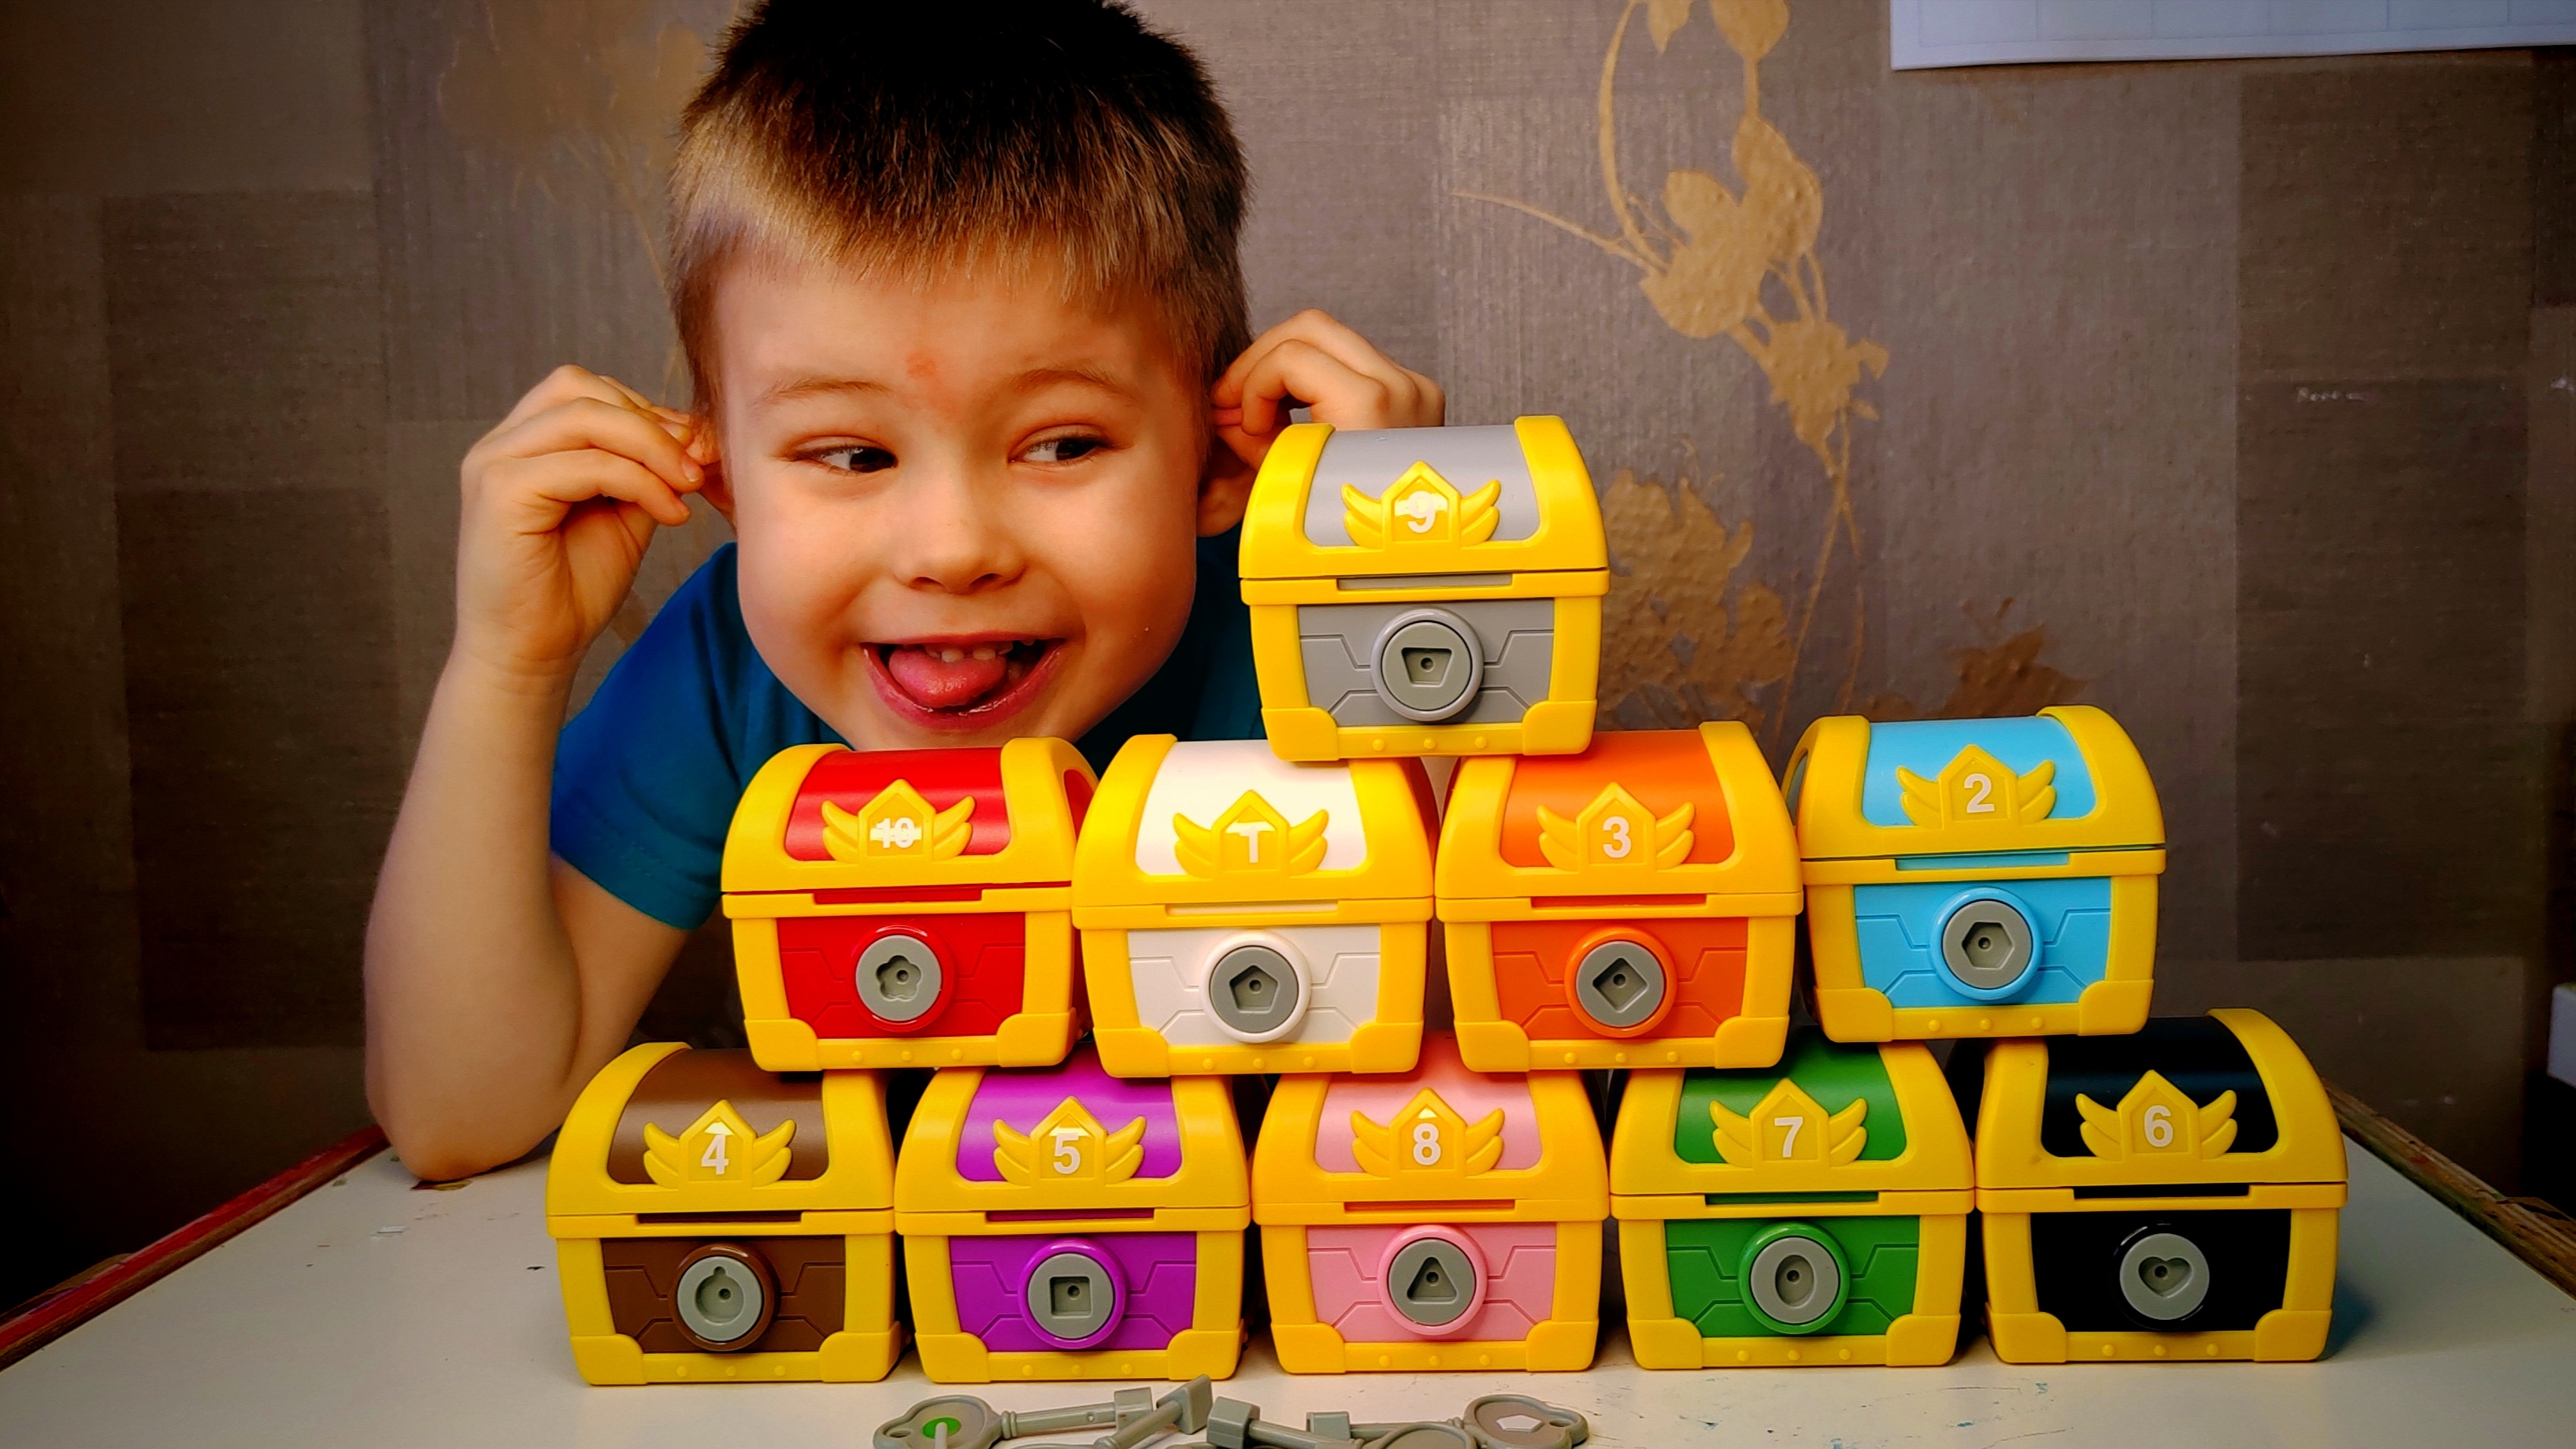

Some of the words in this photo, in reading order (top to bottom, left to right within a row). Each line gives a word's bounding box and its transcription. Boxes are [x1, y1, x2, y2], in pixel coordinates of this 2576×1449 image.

[1407, 491, 1436, 533] 9
[1964, 773, 1995, 813] 2
[876, 817, 914, 849] 10
[1602, 816, 1632, 858] 3
[1413, 1122, 1442, 1166] 8
[1774, 1116, 1803, 1158] 7
[2144, 1105, 2174, 1147] 6
[701, 1132, 730, 1175] 4
[1053, 1132, 1081, 1175] 5
